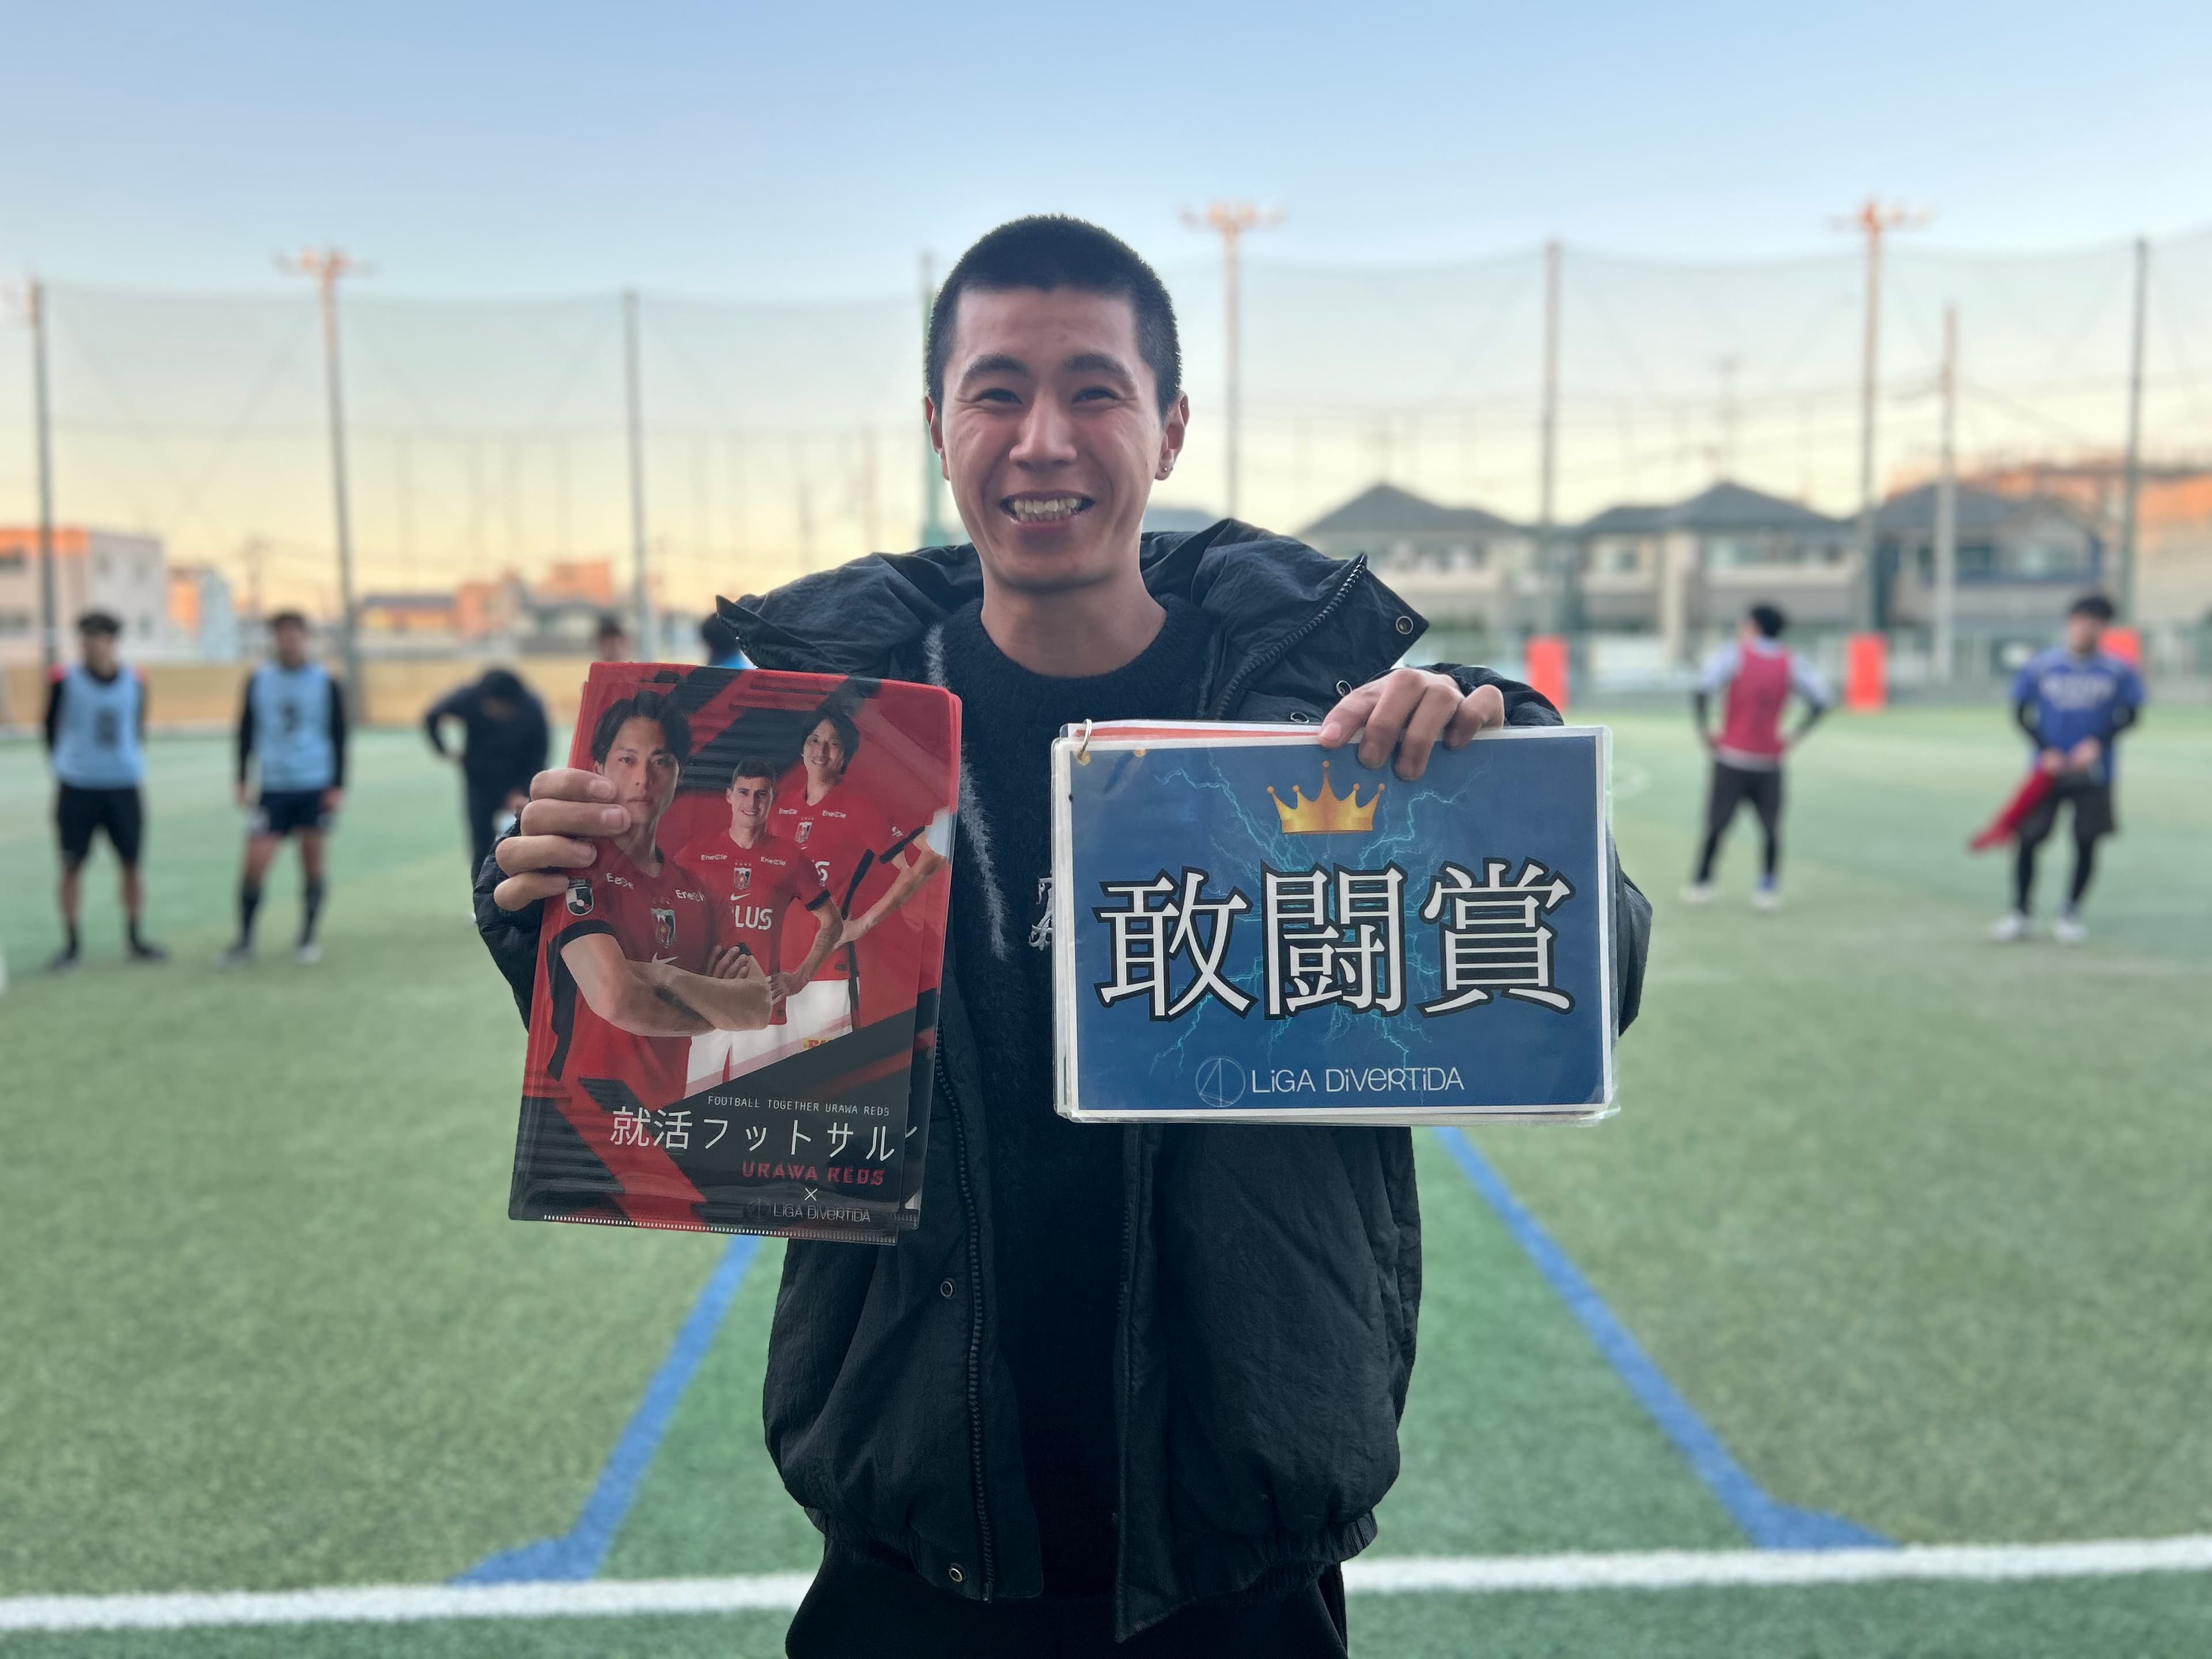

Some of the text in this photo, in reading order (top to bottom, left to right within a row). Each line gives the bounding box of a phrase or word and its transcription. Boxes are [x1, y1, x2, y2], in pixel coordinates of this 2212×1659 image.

[731, 905, 772, 930] LUS
[1093, 858, 1576, 1019] 敢闘賞
[708, 1096, 760, 1108] FOOTBALL
[767, 1099, 819, 1112] TOGETHER
[825, 1103, 858, 1114] URAWA
[609, 1106, 895, 1161] 就活フットサル
[742, 1160, 885, 1185] URAWA REDS
